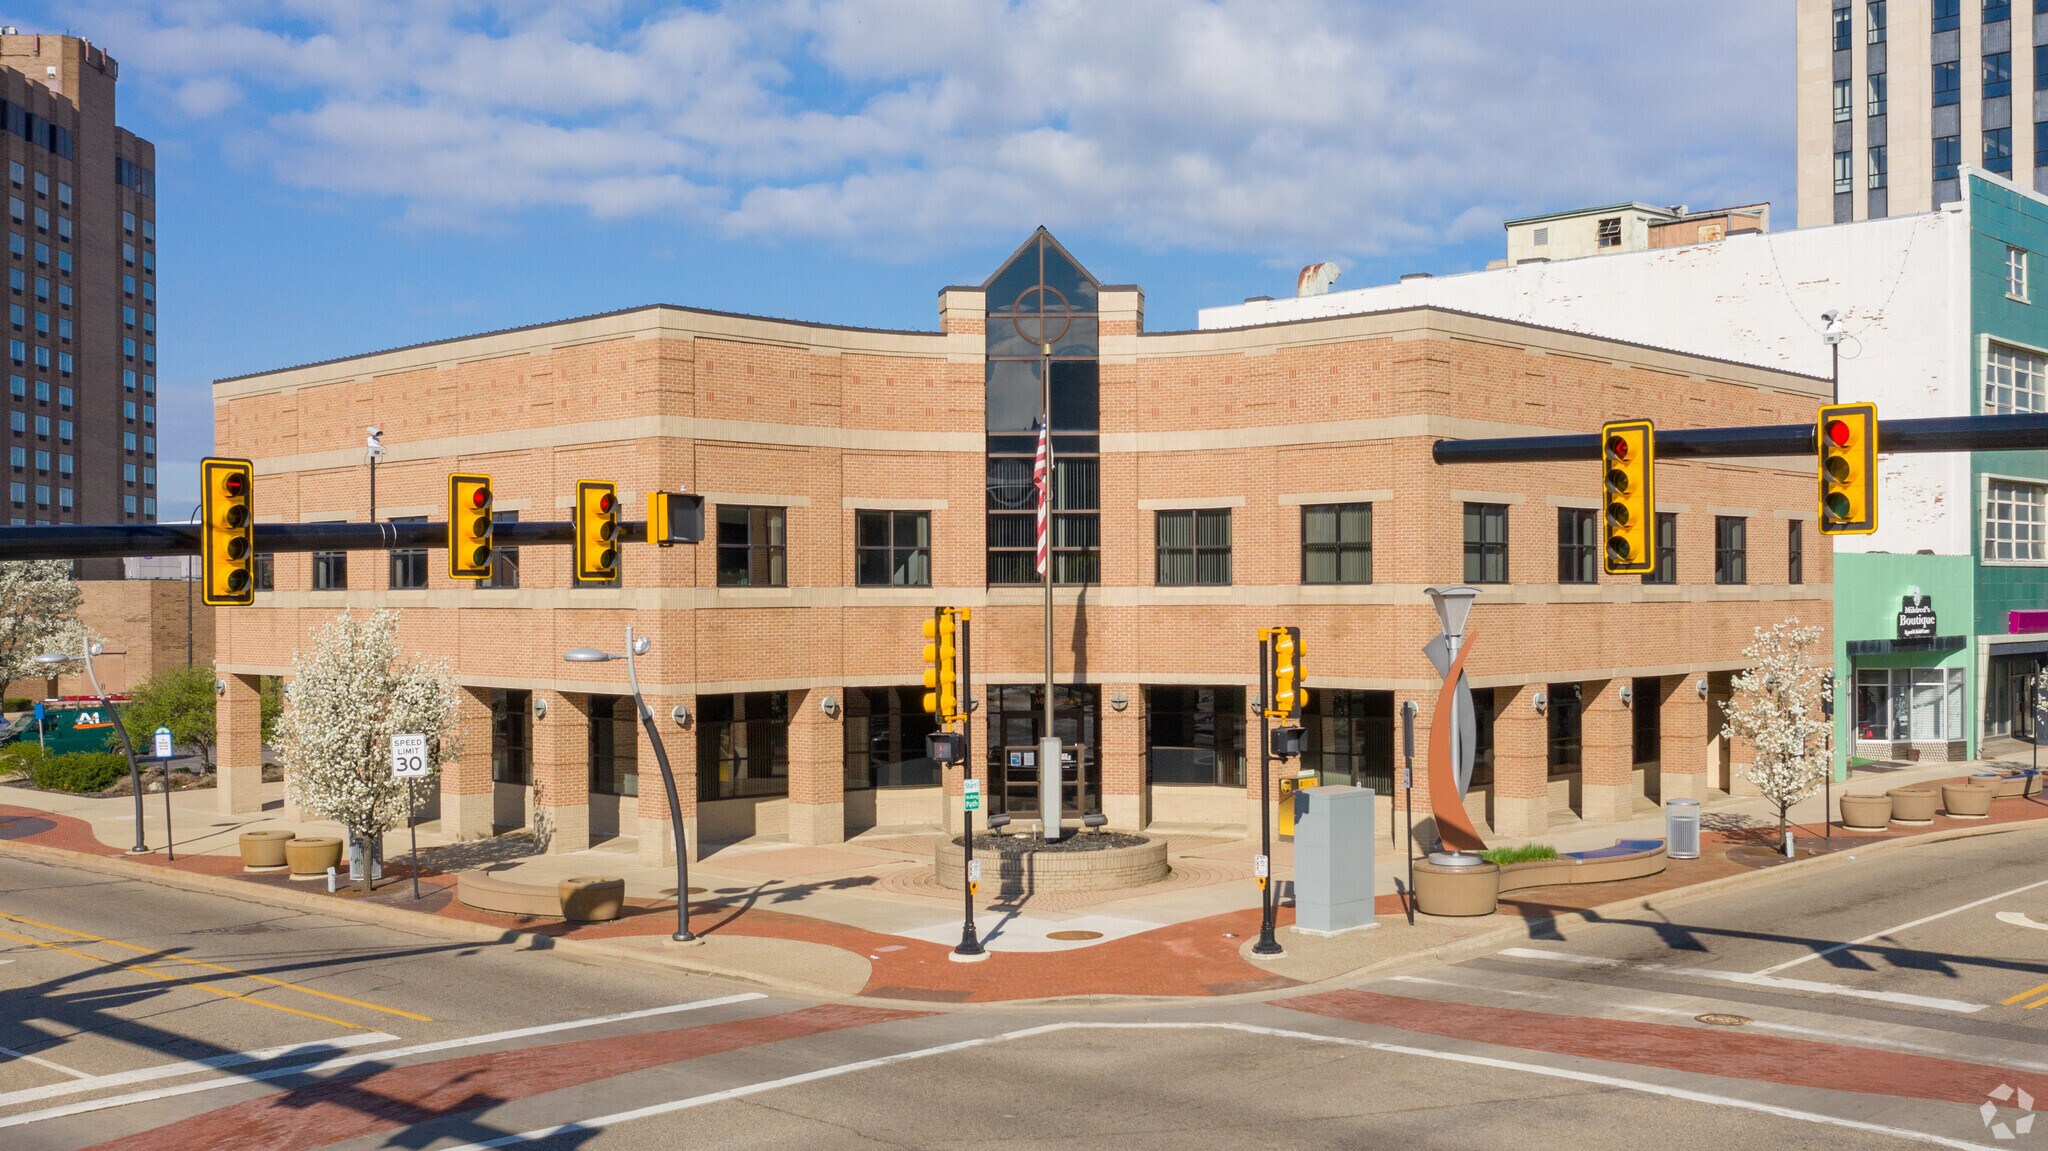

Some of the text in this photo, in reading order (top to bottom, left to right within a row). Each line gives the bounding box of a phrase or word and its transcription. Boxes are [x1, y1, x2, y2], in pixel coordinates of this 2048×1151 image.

[1904, 606, 1930, 614] Mildred's
[1899, 614, 1935, 628] Boutique
[394, 739, 422, 747] SPEED
[397, 747, 419, 755] LIMIT
[396, 756, 422, 772] 30
